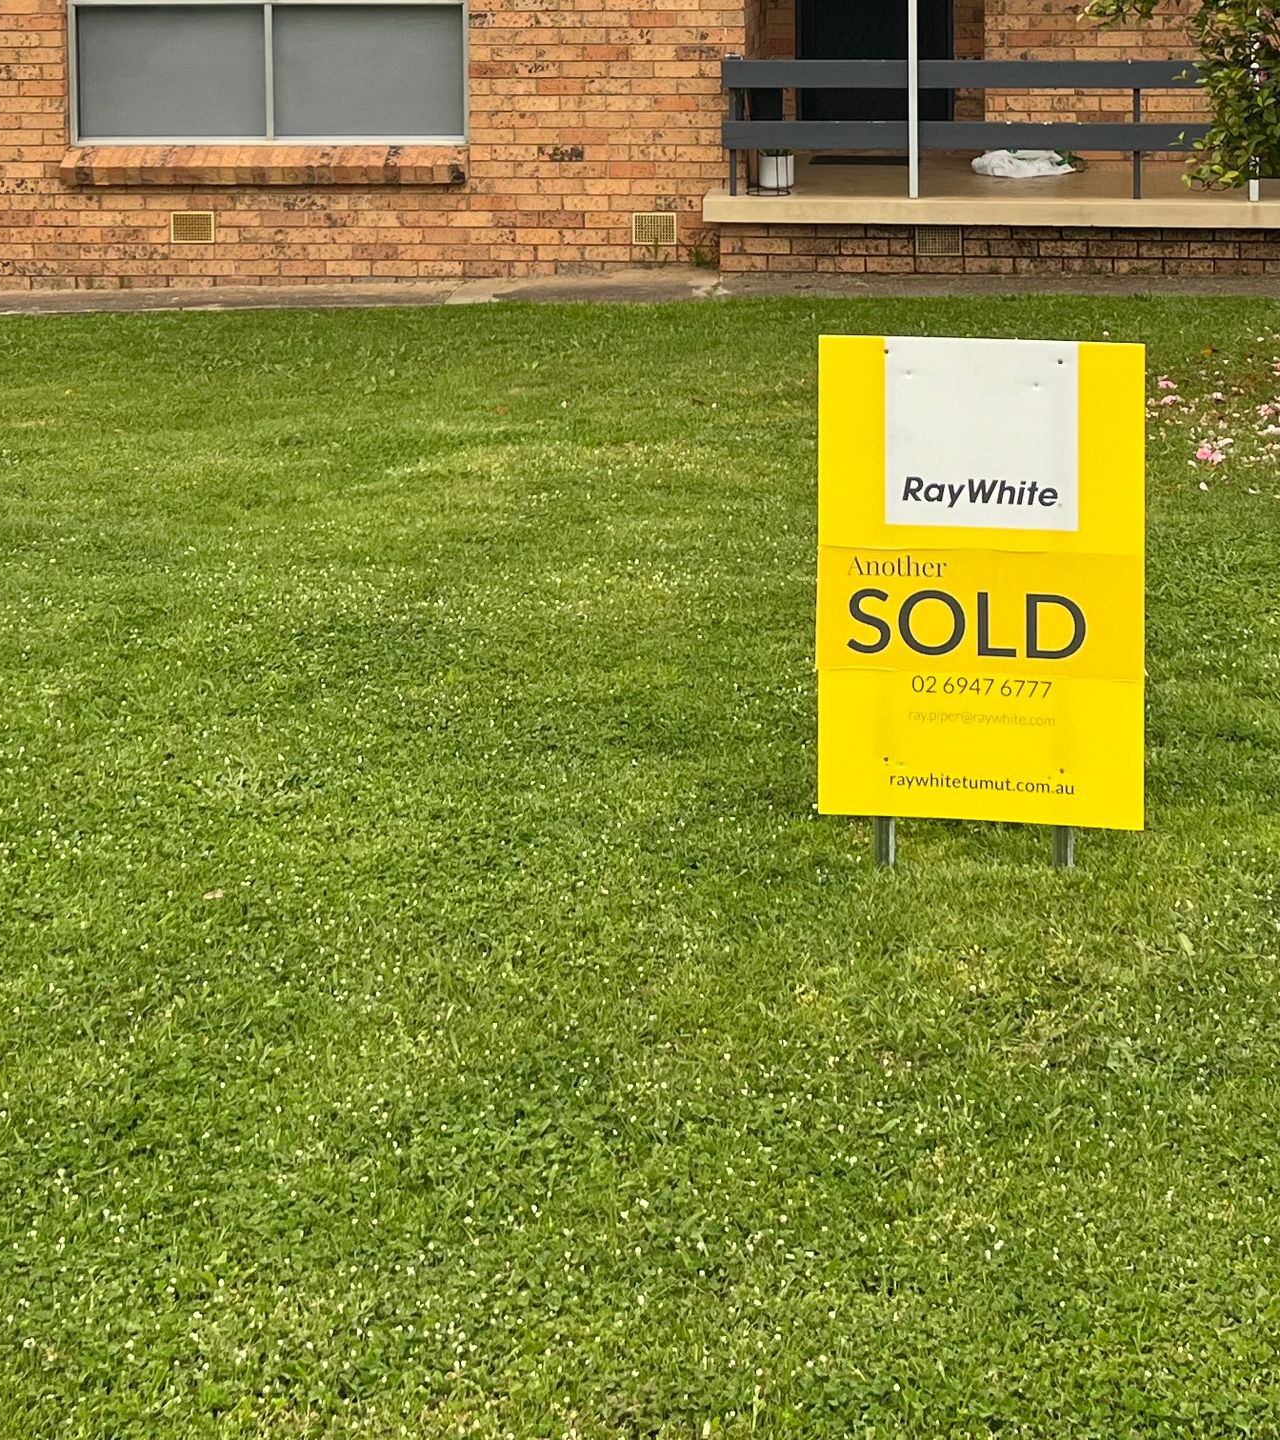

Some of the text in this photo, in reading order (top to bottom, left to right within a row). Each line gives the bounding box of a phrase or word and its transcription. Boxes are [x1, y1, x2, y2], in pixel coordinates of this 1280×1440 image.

[847, 554, 948, 579] Another
[847, 588, 1086, 660] SOLD
[911, 675, 1052, 699] 02 6947 6777
[908, 710, 1056, 728] ray.piper@raywhite.com
[889, 772, 1075, 796] raywhitetumut.com.au
